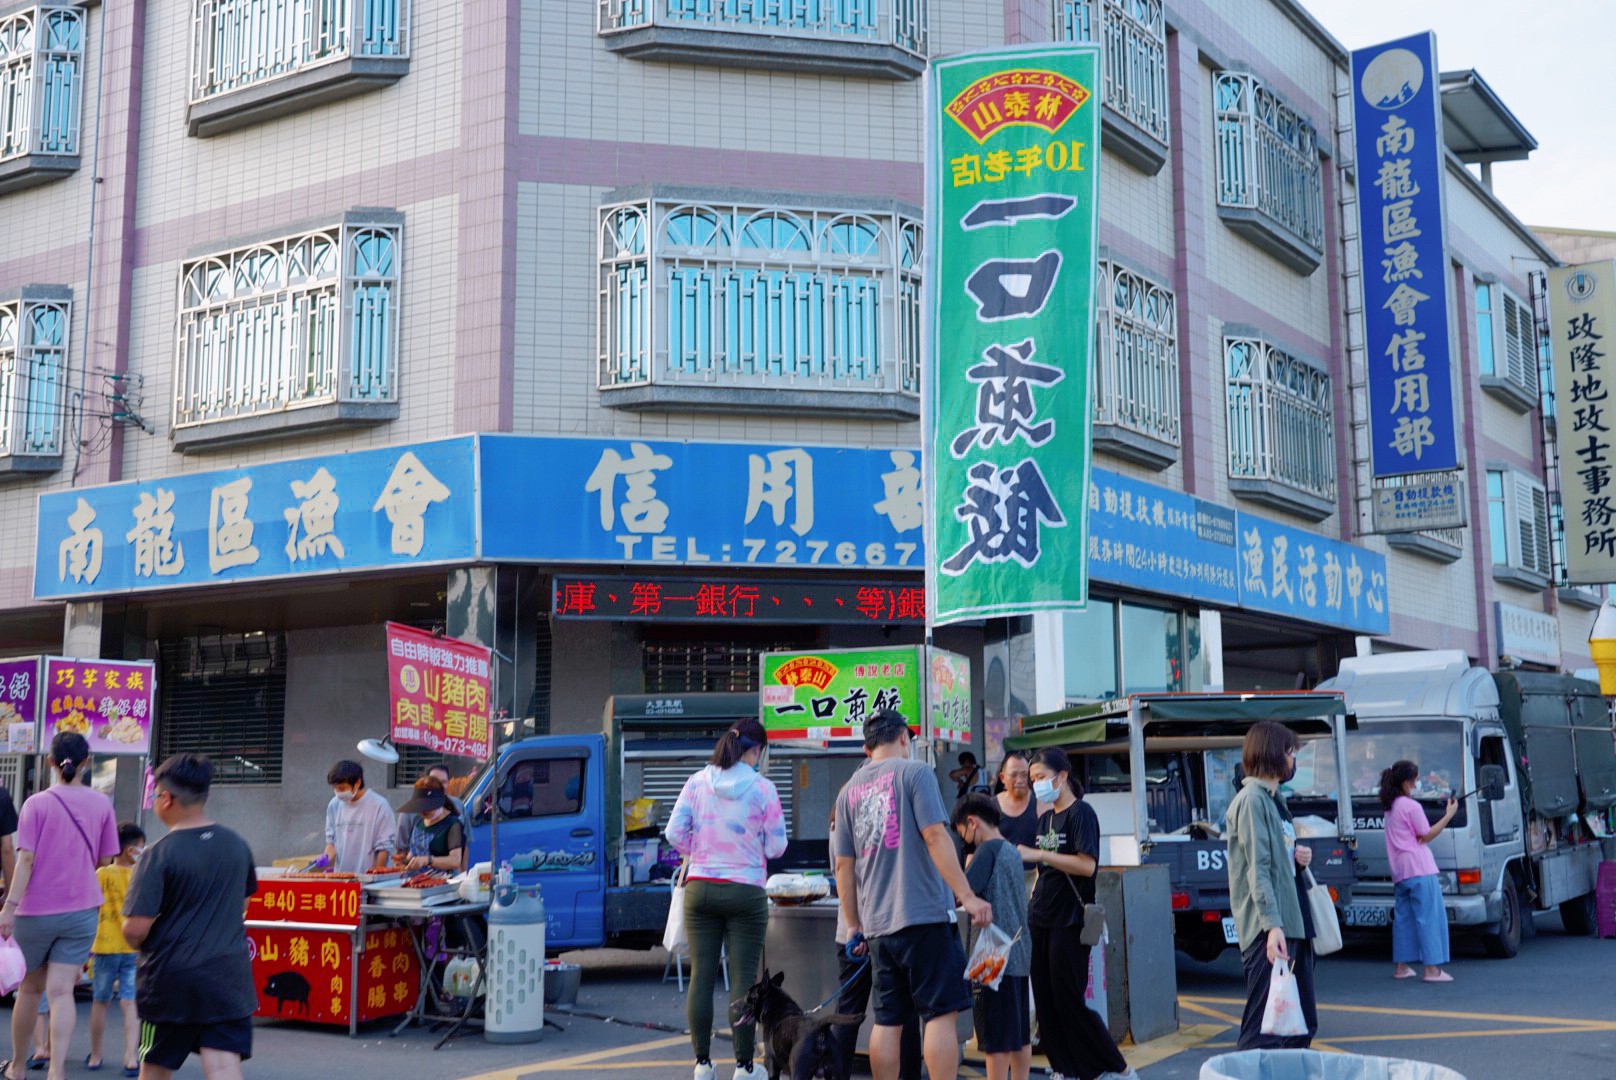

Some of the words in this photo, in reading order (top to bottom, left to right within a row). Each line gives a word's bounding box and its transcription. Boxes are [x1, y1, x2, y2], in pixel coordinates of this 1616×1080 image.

[1374, 114, 1435, 460] 南龍區漁會信用部
[1566, 312, 1616, 560] 政隆地政士事務所
[1089, 480, 1166, 528] 自動提款機
[1394, 484, 1455, 502] 自動提款機
[58, 451, 451, 585] 南龍區漁會
[1242, 526, 1386, 618] 漁民活動中心
[391, 638, 488, 678] 自由時報強力推薦
[785, 667, 827, 687] 林泰山
[854, 663, 905, 678] 傳說老店
[424, 669, 486, 712] 山豬肉
[884, 813, 899, 848] ROAD
[251, 889, 295, 912] 一串40
[300, 889, 357, 918] 三串110
[260, 935, 340, 970] 山豬肉
[330, 975, 343, 1015] 肉串
[367, 954, 387, 1009] 香腸
[392, 952, 410, 1004] 肉串
